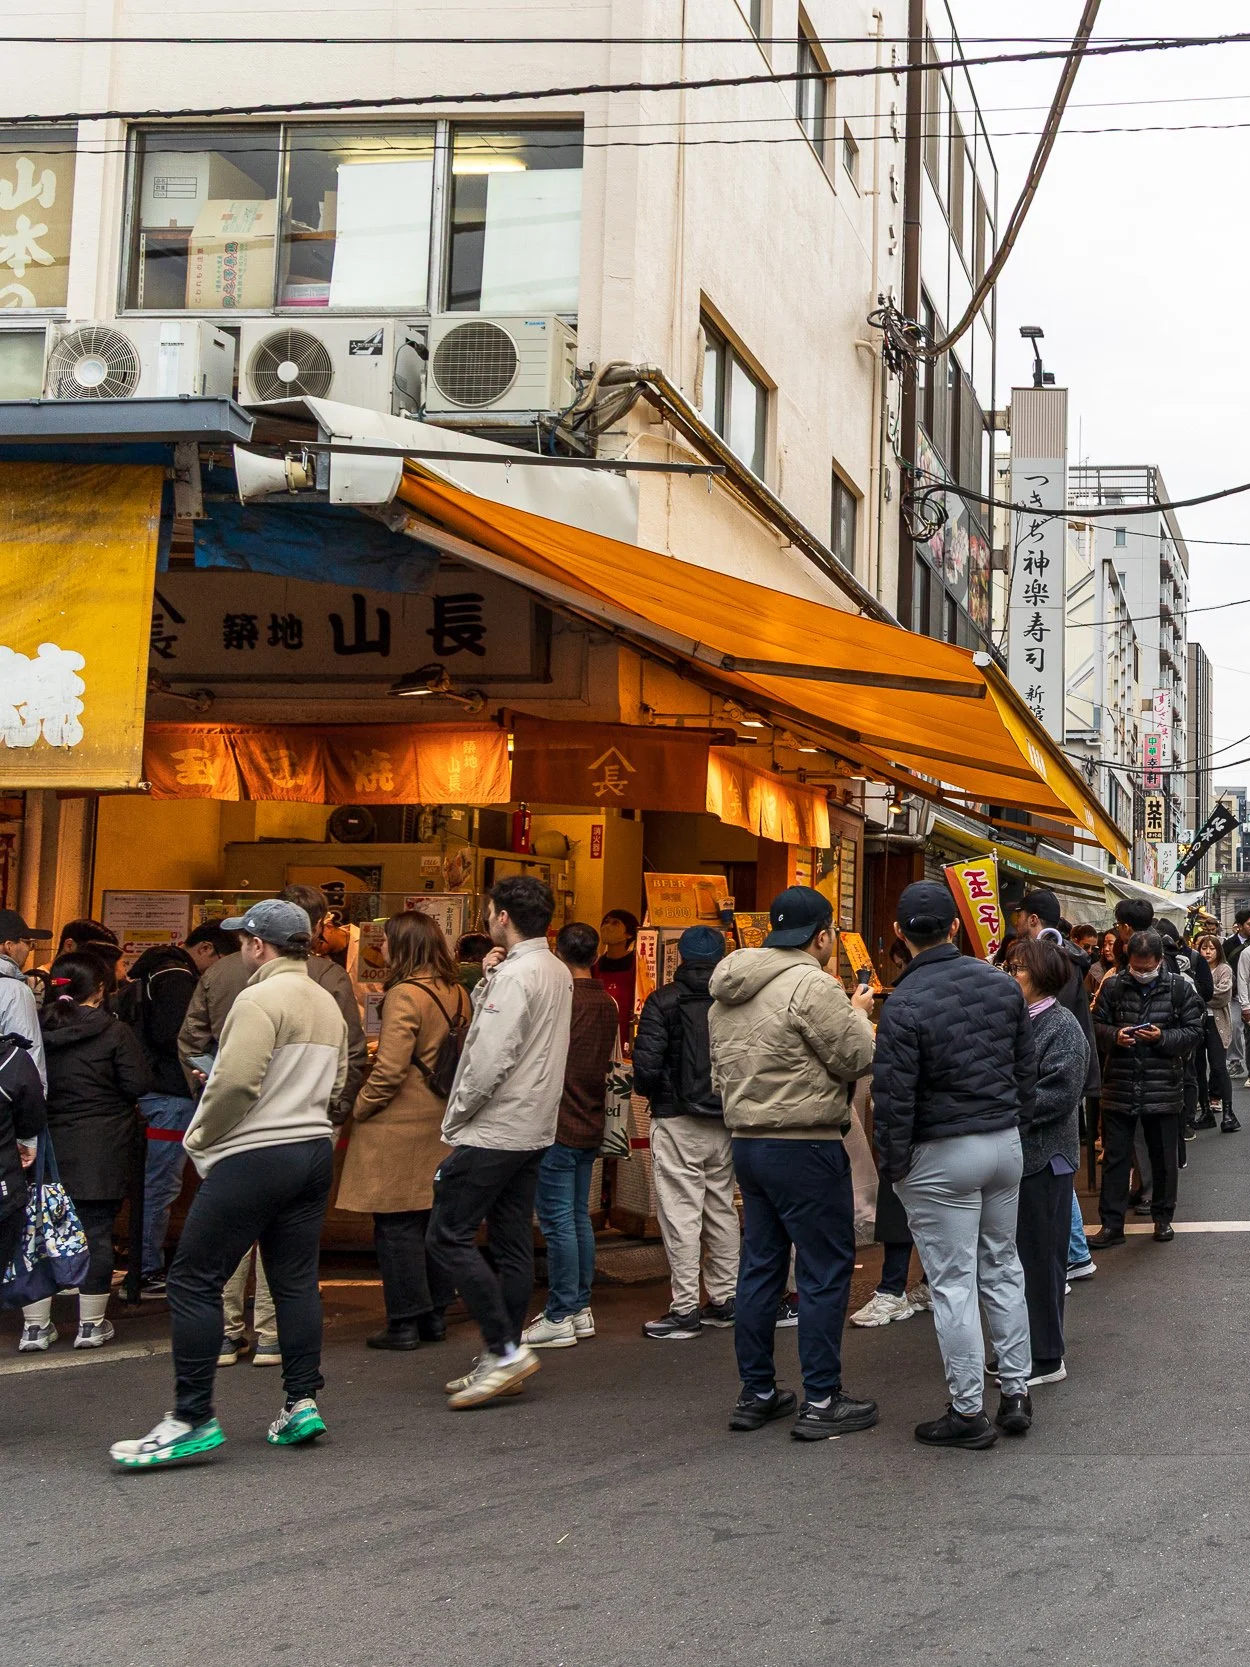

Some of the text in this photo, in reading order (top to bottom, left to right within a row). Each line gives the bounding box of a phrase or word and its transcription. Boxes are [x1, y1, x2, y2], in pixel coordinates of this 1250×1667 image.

[1022, 475, 1052, 673] つきぢ神楽寿司
[222, 592, 488, 657] 築地 山長
[462, 740, 477, 769] 築地
[447, 759, 461, 793] 山長
[591, 826, 602, 853] 消火器
[652, 879, 687, 889] BEER
[606, 1104, 621, 1117] ed
